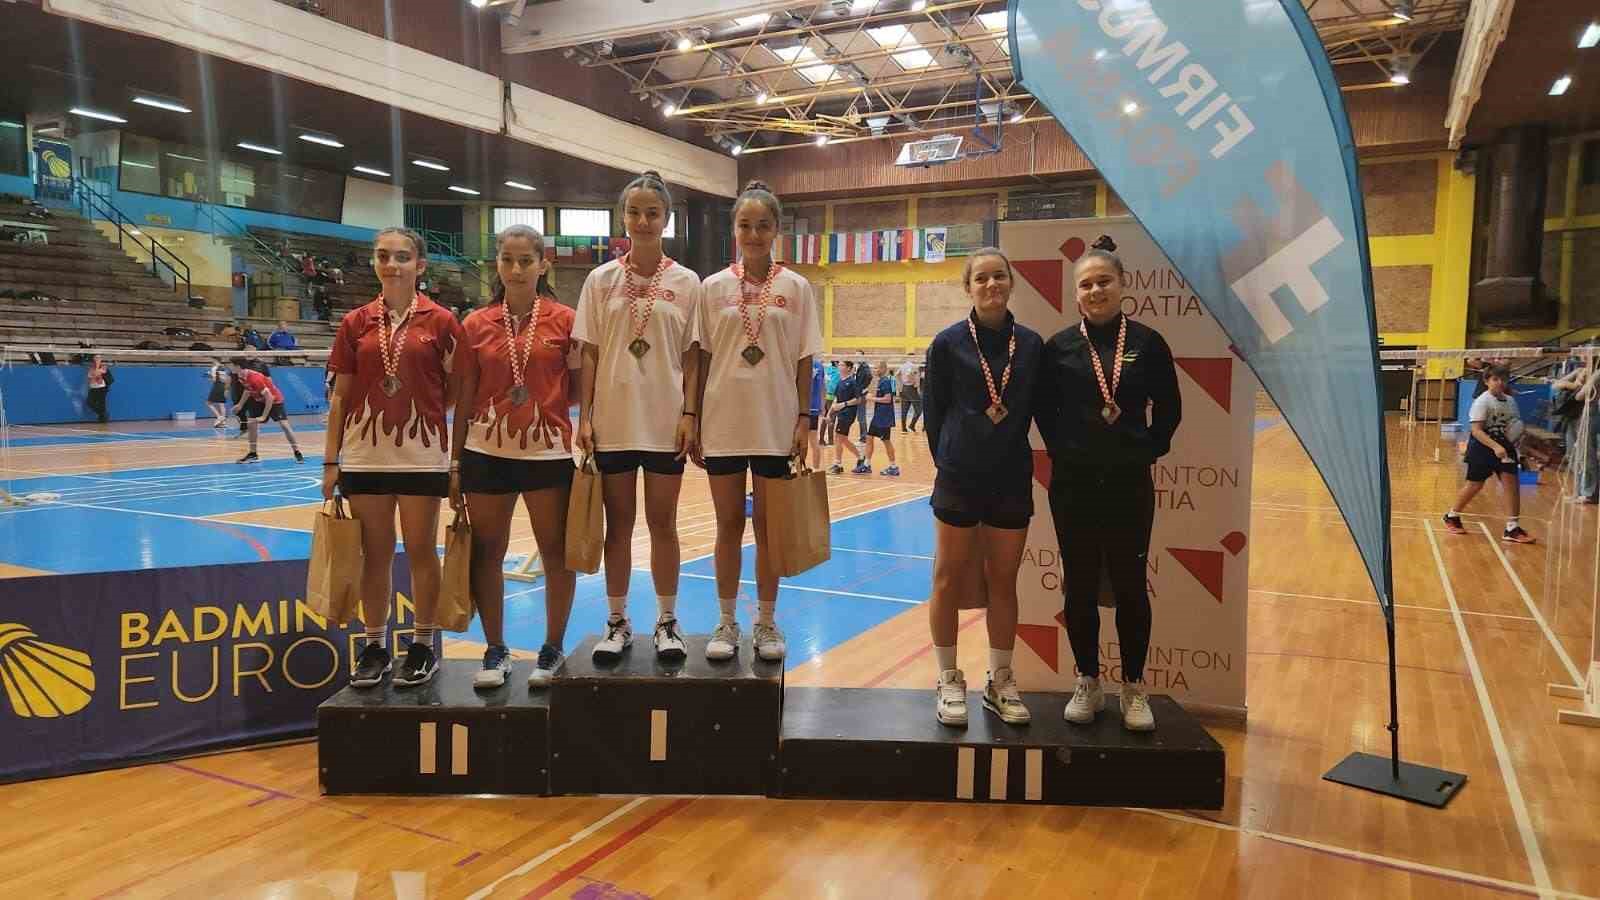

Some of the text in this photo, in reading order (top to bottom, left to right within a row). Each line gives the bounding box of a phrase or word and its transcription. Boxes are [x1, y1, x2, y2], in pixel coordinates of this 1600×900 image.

[1078, 295, 1203, 317] OATIA
[120, 591, 416, 649] BADMINN
[1073, 663, 1190, 691] ROTIA
